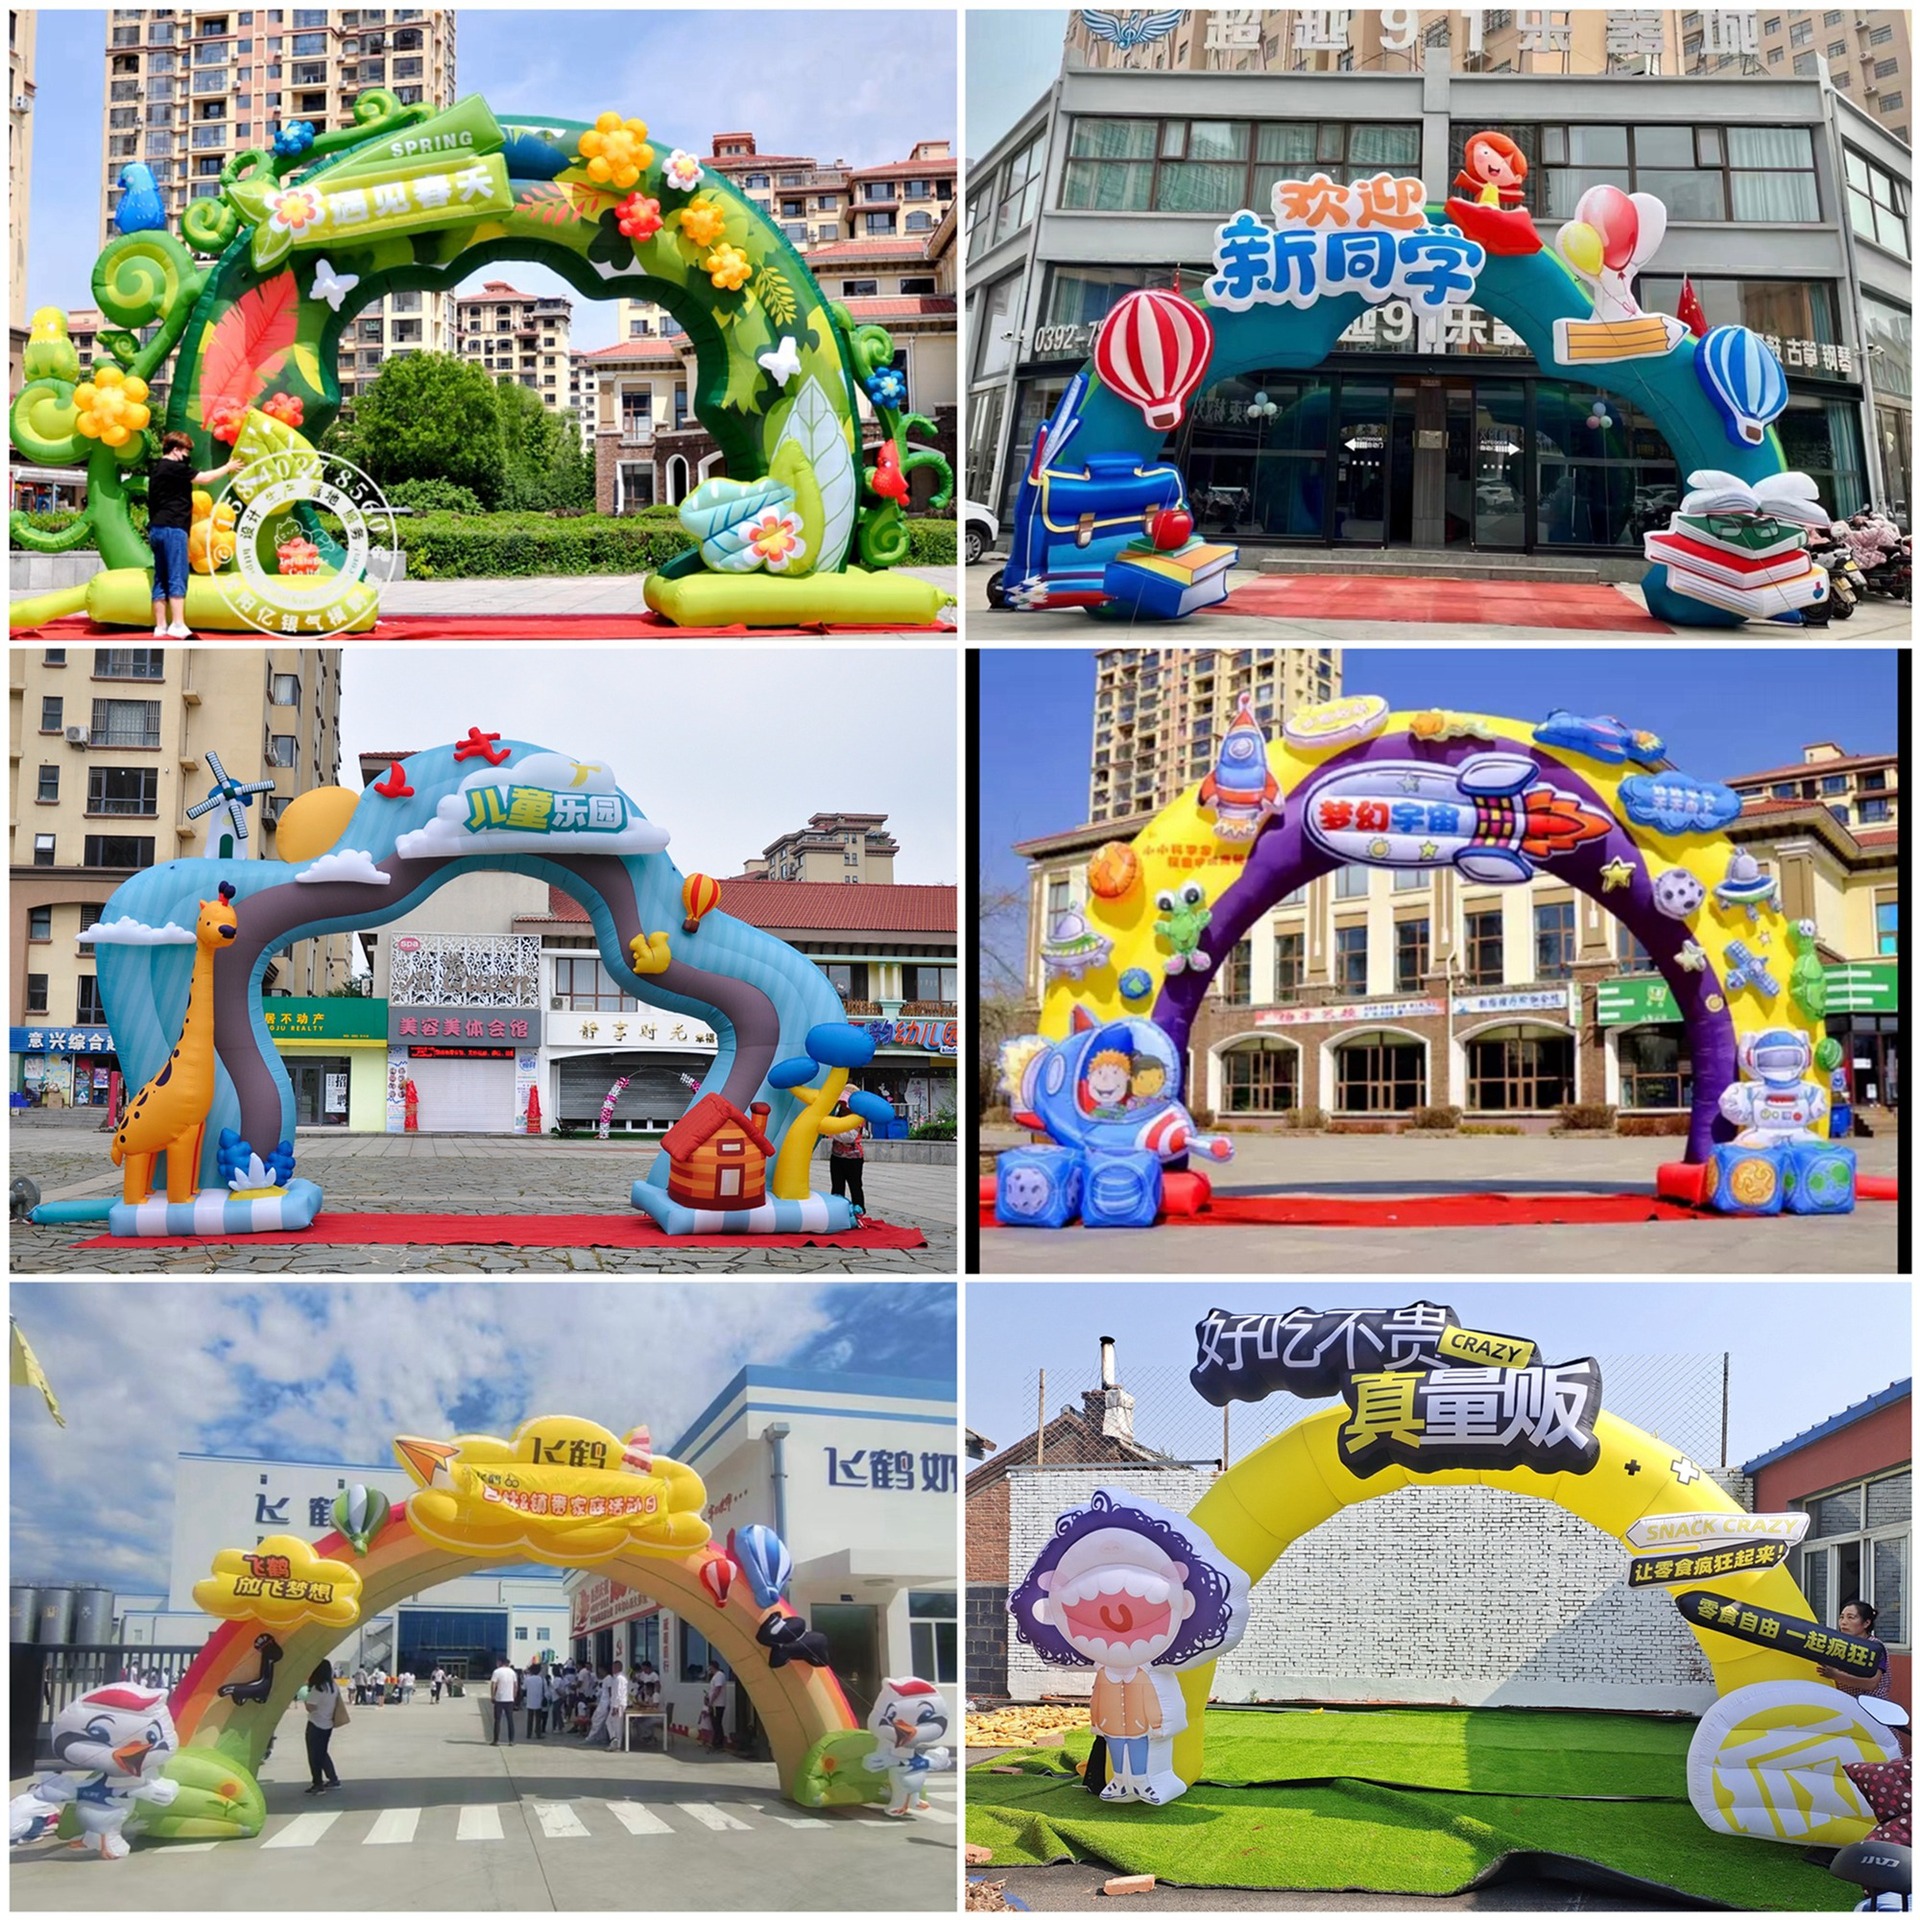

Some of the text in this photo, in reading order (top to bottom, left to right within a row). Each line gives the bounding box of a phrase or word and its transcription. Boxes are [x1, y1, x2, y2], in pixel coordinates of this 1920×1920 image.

[390, 131, 474, 157] SPRING
[329, 165, 495, 225] 遇见春天
[1279, 175, 1425, 229] 欢迎
[1212, 214, 1483, 305] 新同学
[1786, 338, 1818, 368] 古筝
[1822, 343, 1852, 373] 钢琴
[469, 788, 619, 830] 儿童乐园
[1319, 801, 1460, 832] 梦幻宇宙
[400, 940, 419, 949] spa
[265, 1013, 325, 1024] 居不动产
[400, 1017, 529, 1038] 美容美体会馆
[579, 1020, 688, 1042] 静享时光
[1197, 1303, 1452, 1373] 好吃不贵
[1450, 1333, 1523, 1364] CRAZY
[1345, 1361, 1592, 1453] 真量贩
[532, 1436, 607, 1470] 飞鹤
[824, 1447, 957, 1493] 飞鹤奶
[1645, 1516, 1800, 1542] SNACK CRAZY
[243, 1555, 290, 1579] 飞鹤
[1635, 1544, 1785, 1582] 让零食疯狂起来!
[234, 1577, 332, 1604] 放飞梦想
[1697, 1598, 1877, 1668] 零食自由 一起疯狂!
